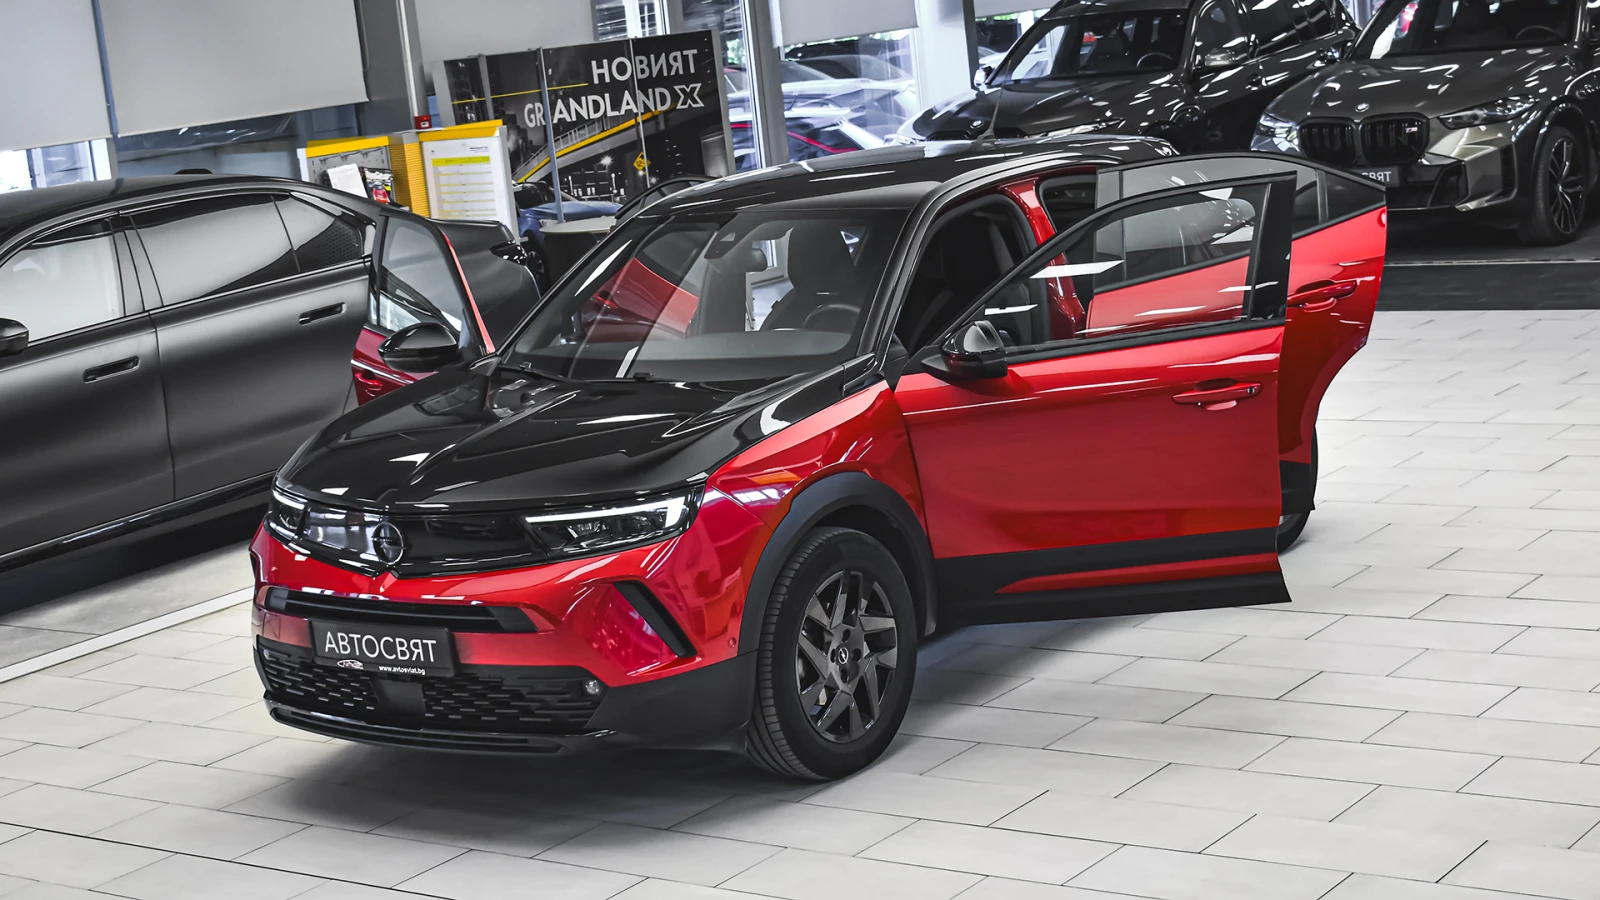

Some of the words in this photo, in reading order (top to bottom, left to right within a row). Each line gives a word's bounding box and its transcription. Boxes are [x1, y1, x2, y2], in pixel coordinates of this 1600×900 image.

[591, 49, 698, 84] НОВИЯТ
[524, 87, 672, 128] GRANDLAND
[673, 83, 704, 109] X
[325, 631, 437, 662] АВТОСВЯТ
[378, 666, 426, 676] www.avtosviat.bg
